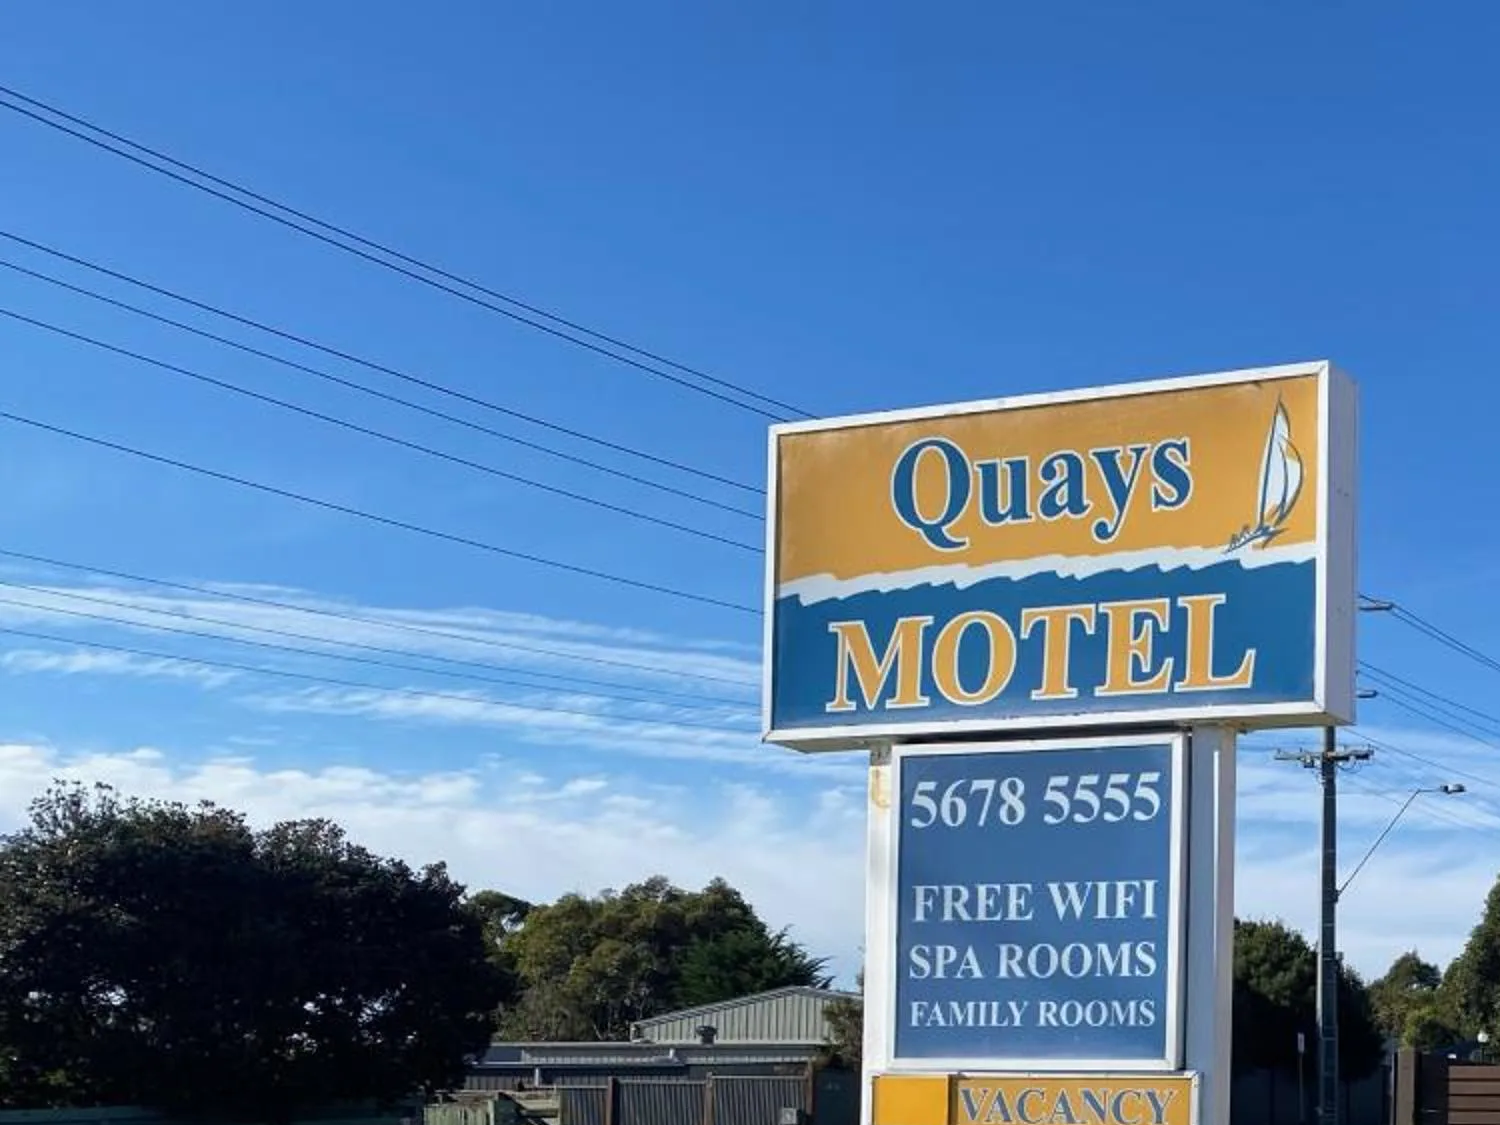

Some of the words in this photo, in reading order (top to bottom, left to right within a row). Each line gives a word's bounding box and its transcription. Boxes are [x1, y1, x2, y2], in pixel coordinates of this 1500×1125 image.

[890, 434, 1194, 552] Quays
[825, 593, 1256, 713] MOTEL
[911, 777, 1026, 828] 5678
[1043, 771, 1161, 825] 5555
[912, 883, 1033, 922] FREE
[1047, 880, 1158, 920] WIFI
[909, 944, 984, 979] SPA
[996, 941, 1157, 978] ROOMS
[910, 1000, 1030, 1027] FAMILY
[1036, 1000, 1156, 1027] ROOMS
